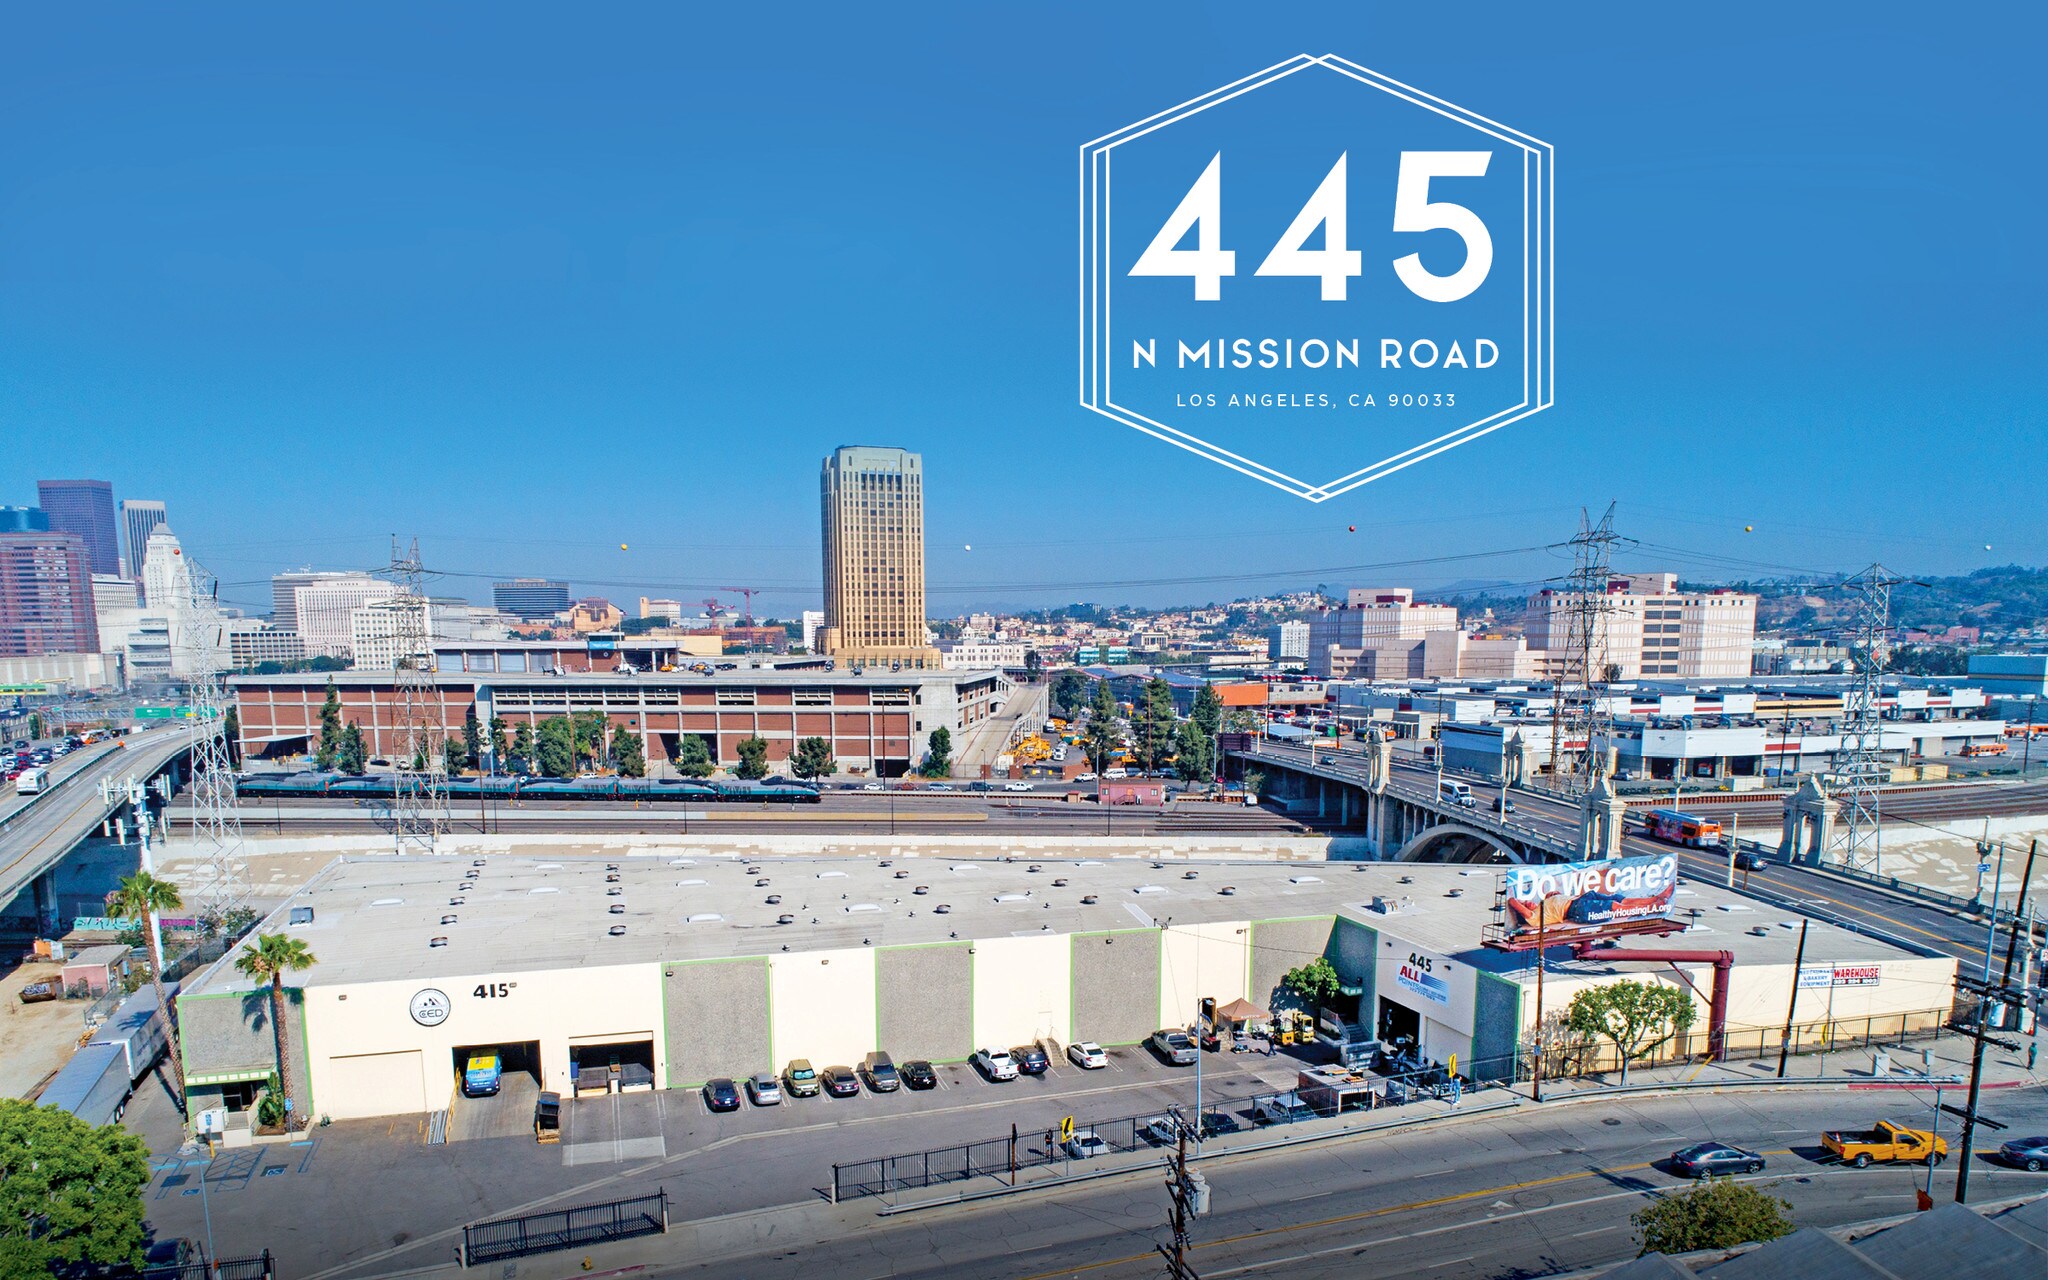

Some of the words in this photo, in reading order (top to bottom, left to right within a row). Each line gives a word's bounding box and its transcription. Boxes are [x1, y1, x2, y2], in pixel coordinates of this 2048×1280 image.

[1516, 869, 1556, 900] Do
[1561, 867, 1600, 897] we
[1604, 856, 1675, 893] care?
[1587, 904, 1672, 921] HealthyHousingLA.org
[1409, 952, 1432, 973] 445
[1400, 965, 1419, 983] ALL
[1834, 968, 1879, 979] WAREHOUSE
[473, 983, 509, 999] 415
